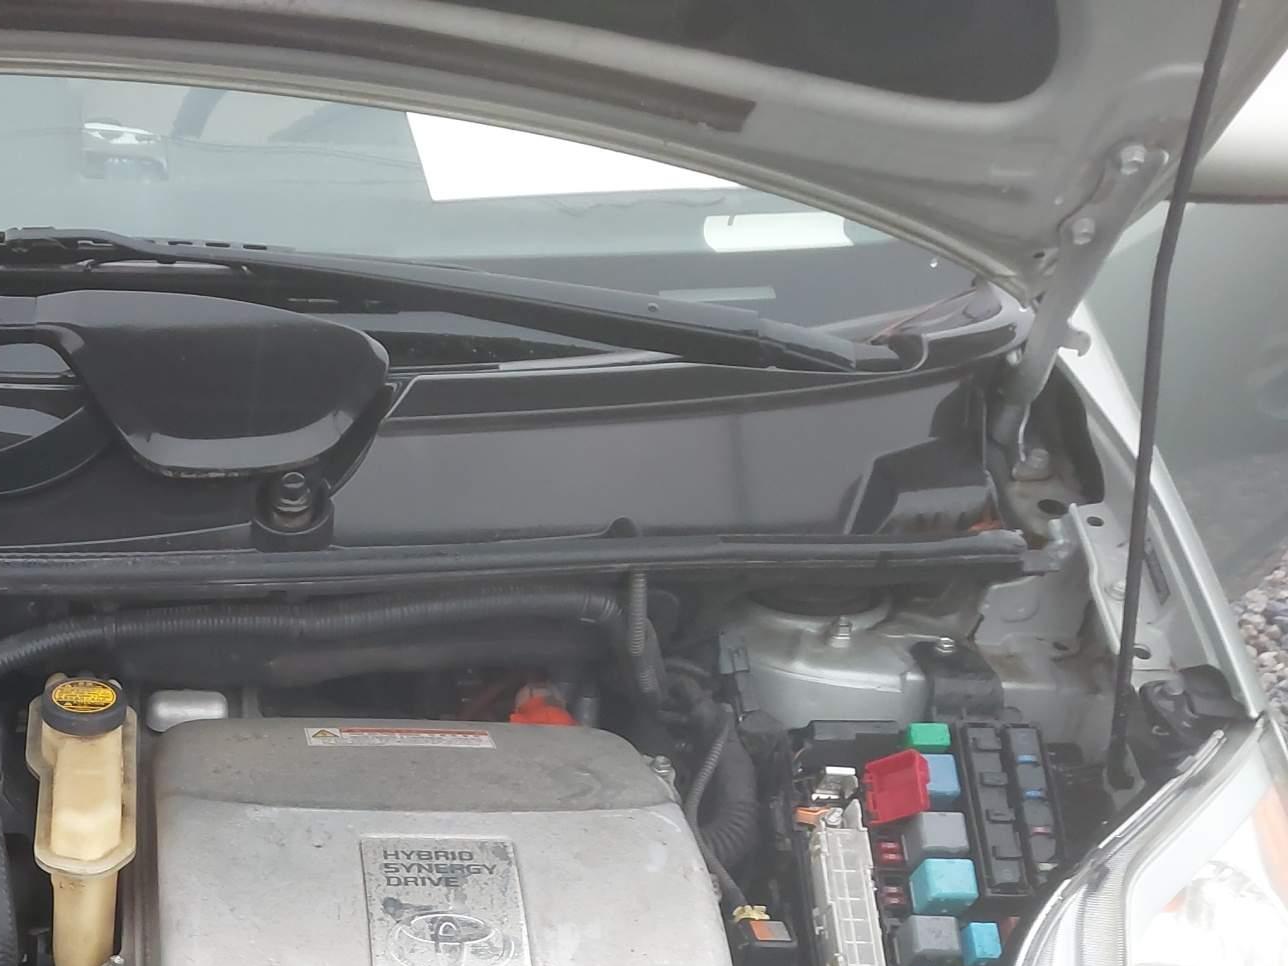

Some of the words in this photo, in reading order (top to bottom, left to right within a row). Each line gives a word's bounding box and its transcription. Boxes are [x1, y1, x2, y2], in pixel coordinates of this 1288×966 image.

[383, 849, 474, 861] HYBRID
[383, 862, 497, 875] SYNERGY
[386, 875, 461, 888] DRIVE
